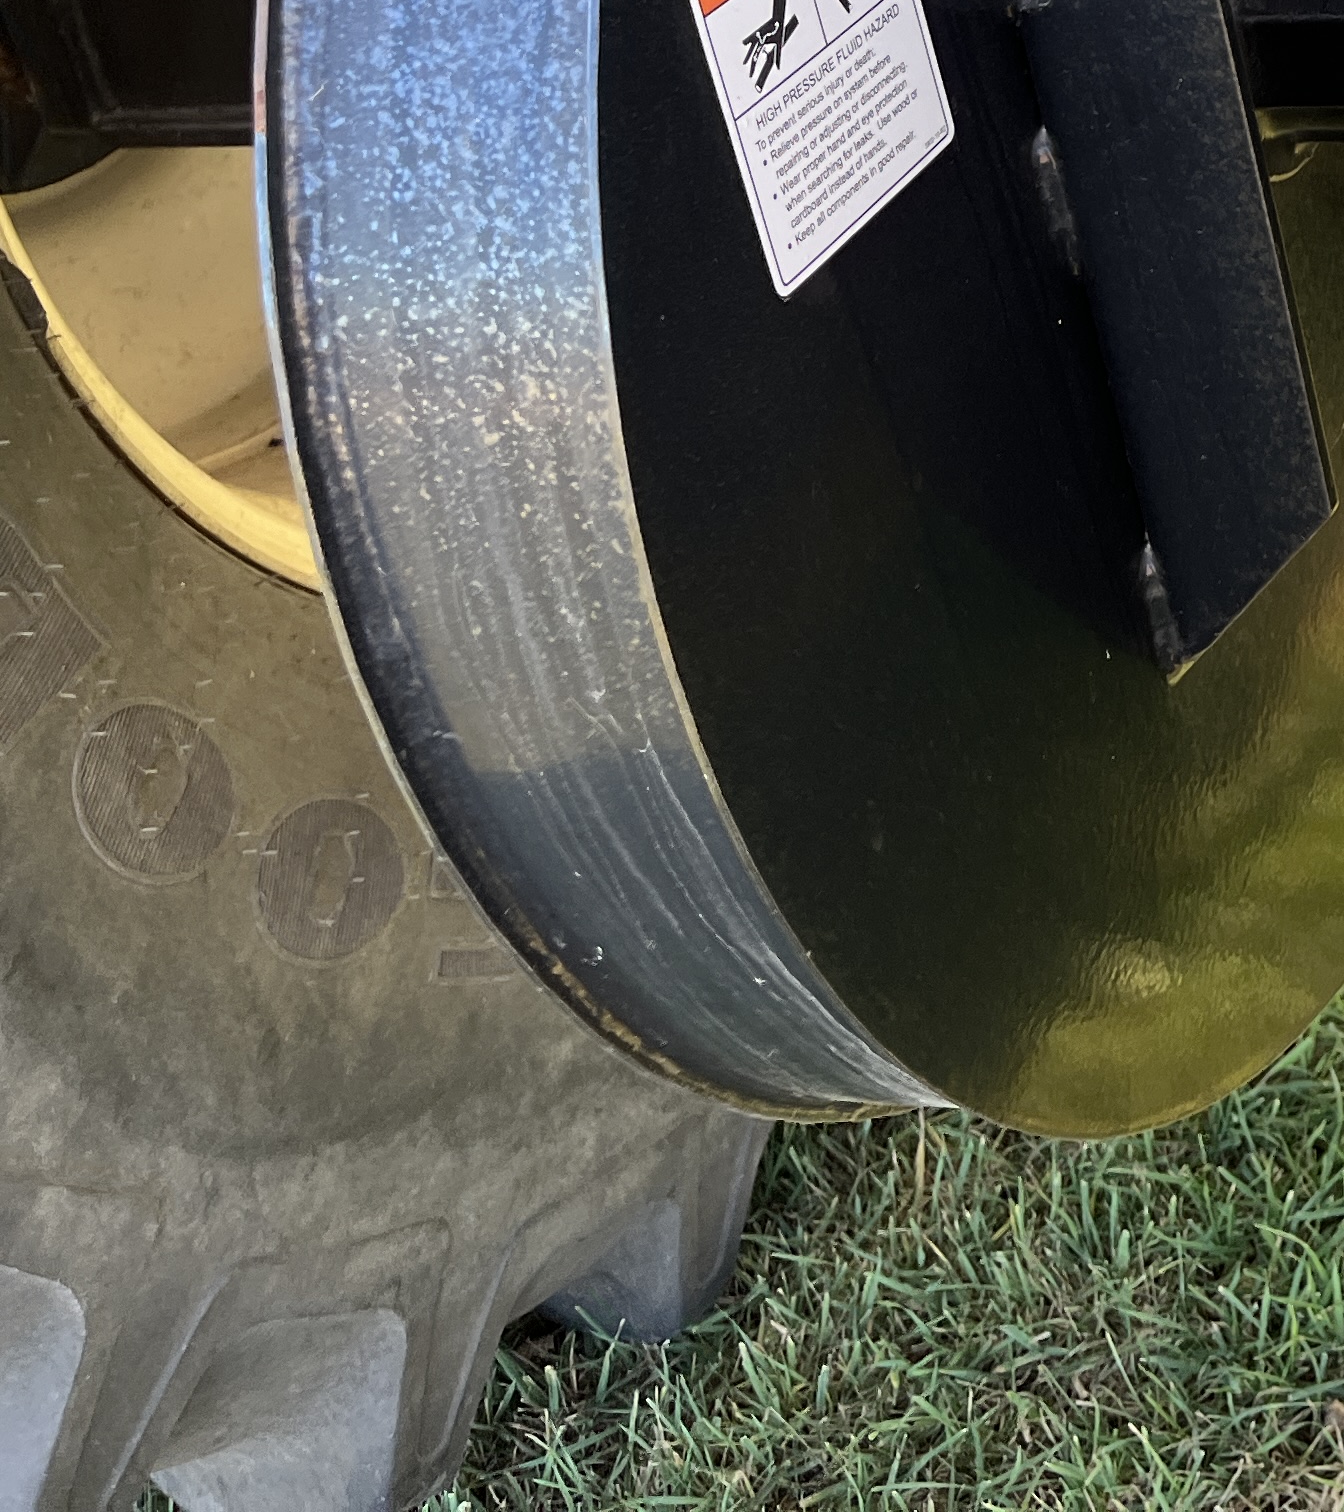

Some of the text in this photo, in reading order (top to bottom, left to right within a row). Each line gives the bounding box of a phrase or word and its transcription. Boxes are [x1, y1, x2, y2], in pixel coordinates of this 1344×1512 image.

[755, 1, 900, 131] HIGH PRESSURE FLUID HAZARD
[755, 135, 767, 154] To
[766, 112, 797, 147] prevent
[796, 88, 824, 120] serious
[823, 70, 845, 100] injury
[844, 66, 853, 79] or
[769, 50, 891, 163] Relieve pressure on system before
[774, 56, 908, 182] repairing or adjusting or disconnecting.
[779, 76, 908, 197] Wear proper hand and eye protection
[784, 87, 918, 213] when searching for leaks. Use wood or
[789, 187, 828, 230] cardboard
[827, 161, 855, 196] instead
[854, 155, 864, 171] of
[862, 133, 887, 164] hands.
[794, 218, 816, 249] Keep
[815, 209, 826, 227] all
[825, 169, 870, 220] components
[868, 162, 877, 177] in
[876, 146, 896, 173] good
[894, 126, 916, 156] repair.
